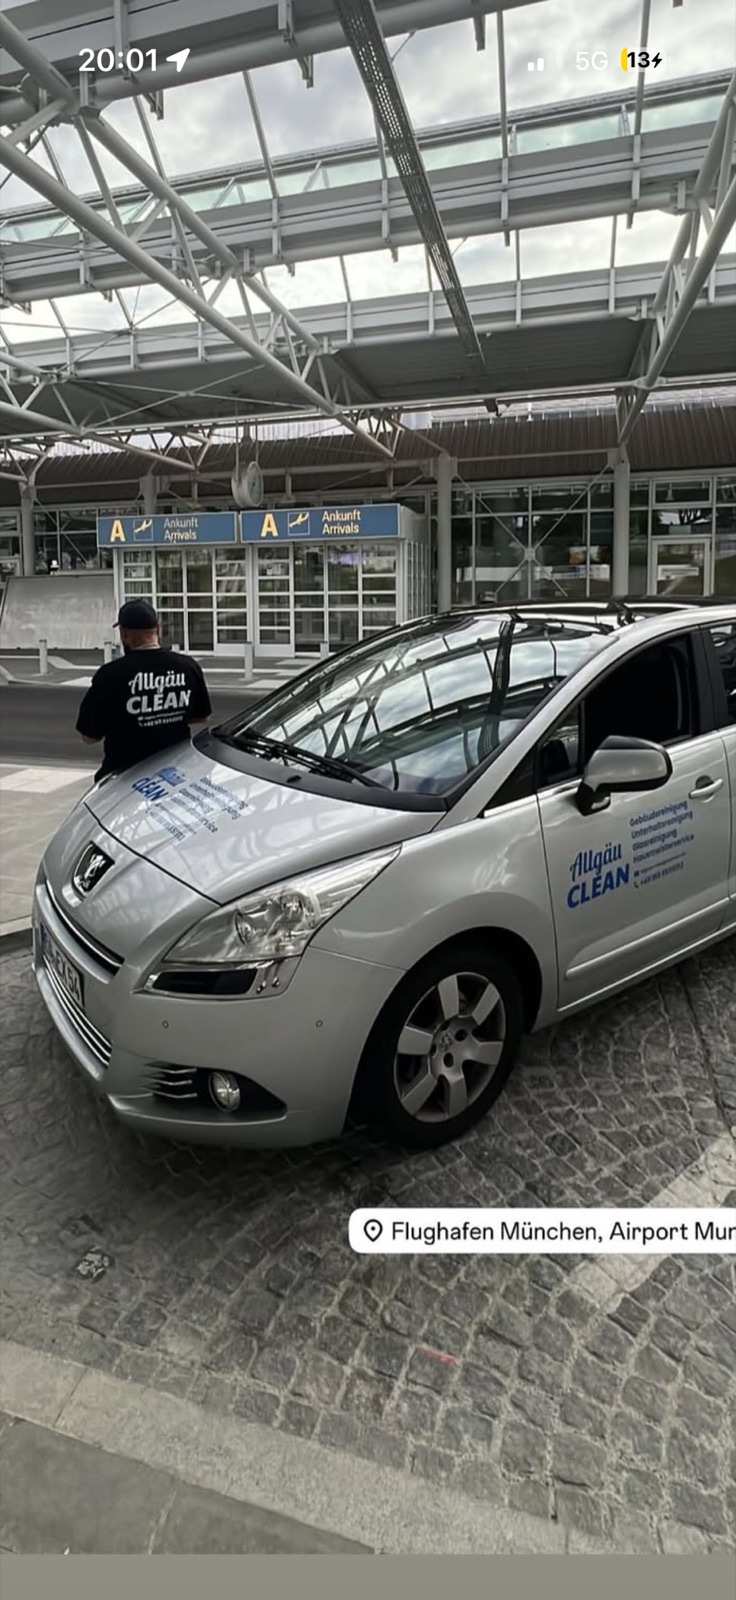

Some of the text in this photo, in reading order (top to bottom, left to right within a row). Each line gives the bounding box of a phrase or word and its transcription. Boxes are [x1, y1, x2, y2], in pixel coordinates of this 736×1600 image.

[163, 517, 199, 529] Ankunft
[261, 513, 279, 538] A
[322, 509, 362, 522] Ankunft
[110, 519, 126, 542] A
[163, 529, 198, 541] Arrivals
[322, 523, 360, 536] Arrivals
[128, 670, 186, 695] Allgäu
[126, 689, 192, 715] CLEAN
[569, 842, 622, 882] Allgäu
[567, 863, 630, 909] CLEAN
